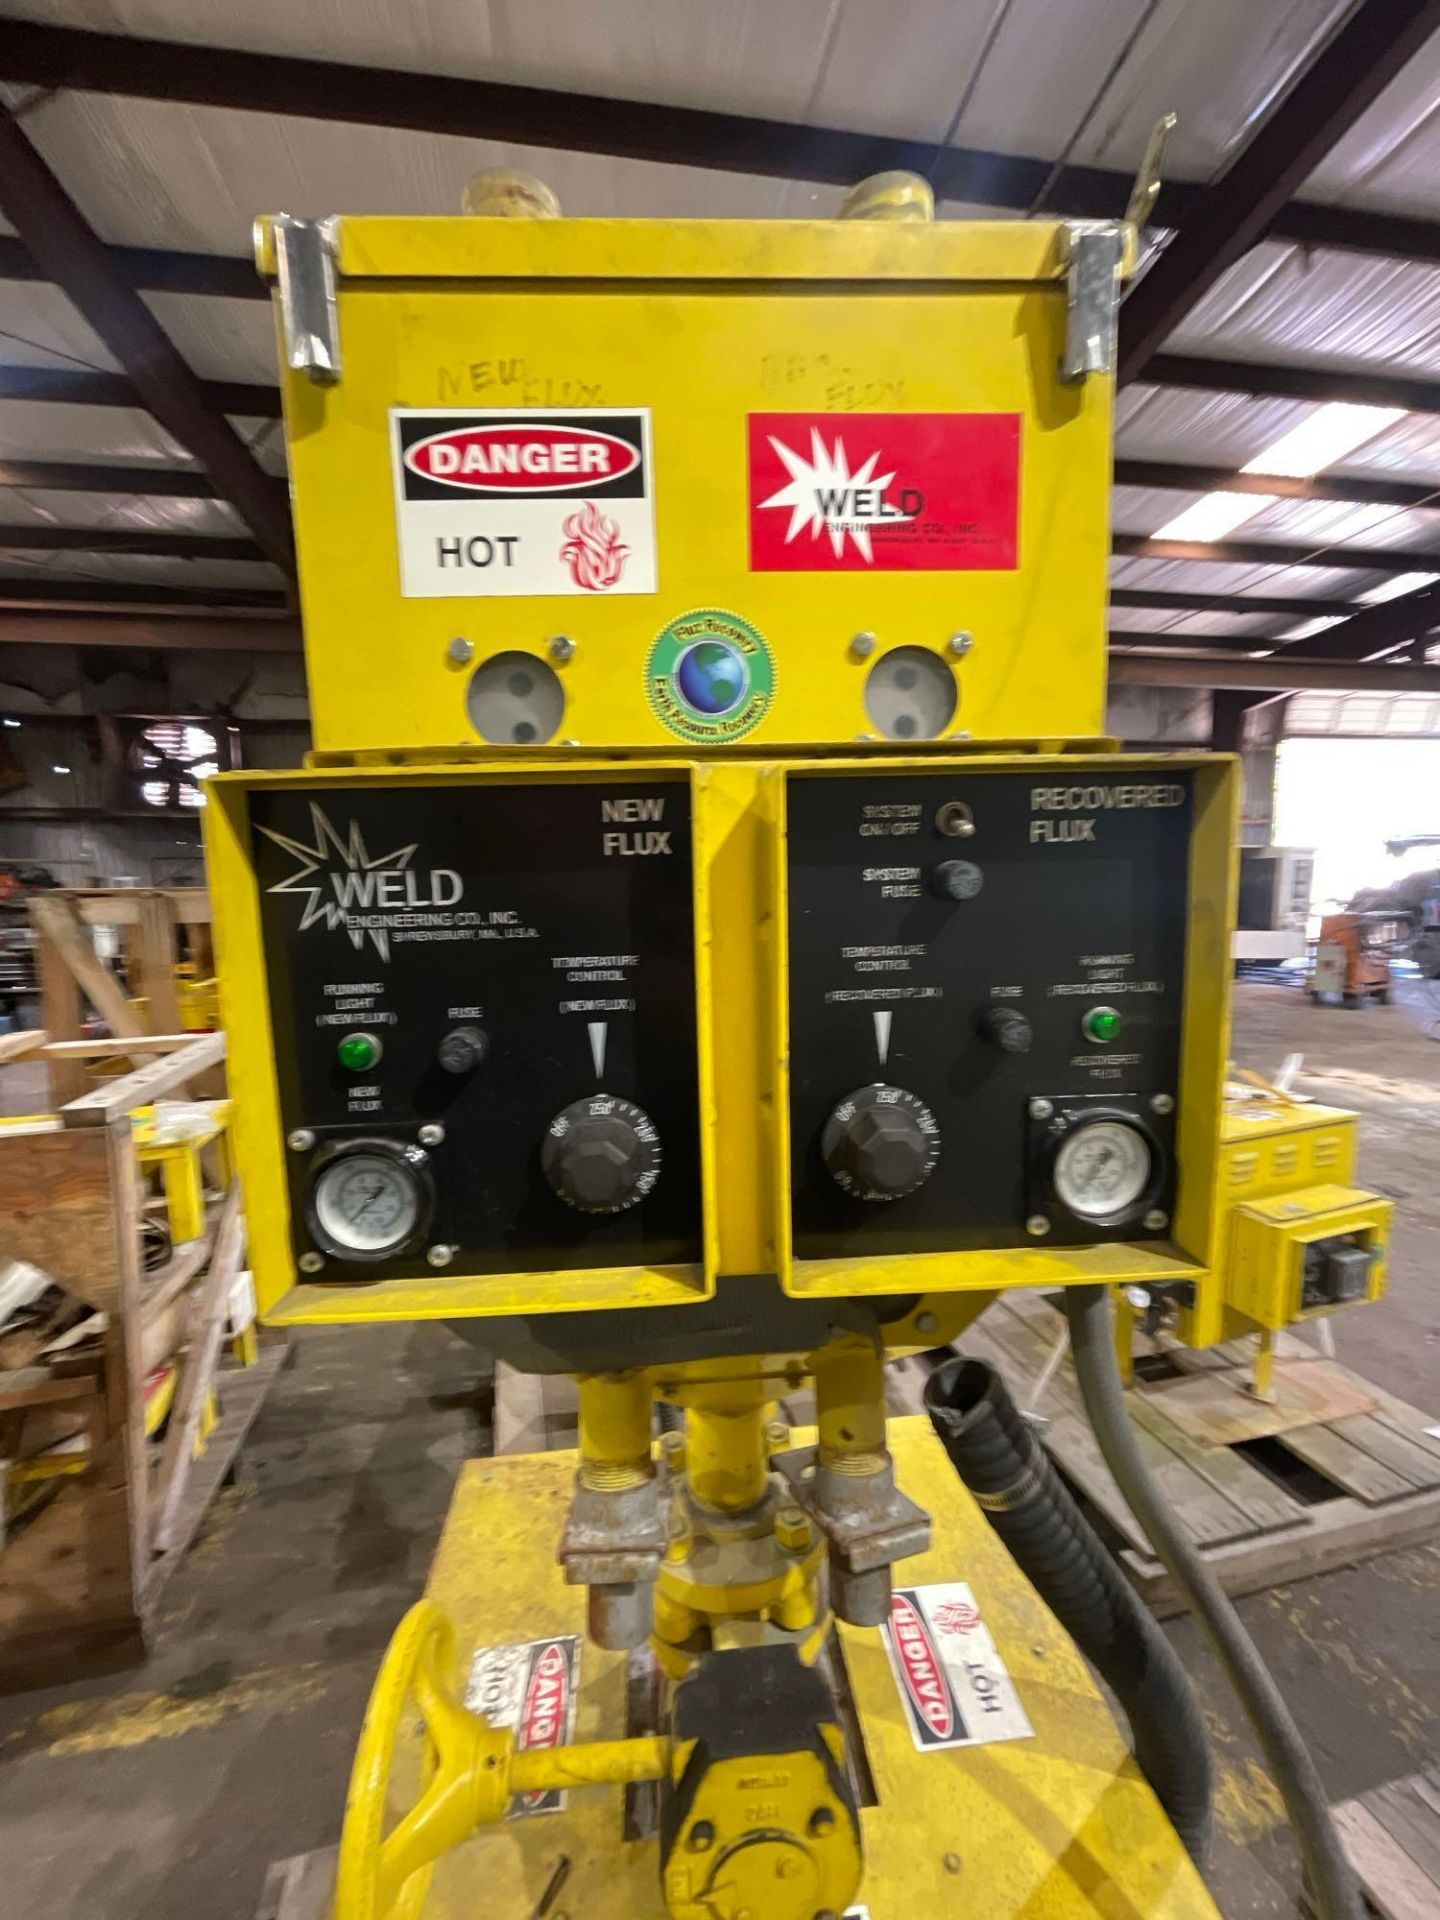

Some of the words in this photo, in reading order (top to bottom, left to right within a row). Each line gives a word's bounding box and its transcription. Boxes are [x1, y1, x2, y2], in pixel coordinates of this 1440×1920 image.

[427, 443, 611, 474] DANGER
[814, 488, 925, 517] WELD
[436, 536, 521, 567] HOT
[1031, 785, 1185, 811] RECOVERED
[602, 799, 665, 823] NEW
[1030, 819, 1095, 843] FLUX
[603, 832, 672, 856] FLUX
[863, 868, 921, 881] SYSTEM
[329, 869, 464, 908] WELD
[881, 885, 921, 898] FUSE
[347, 912, 454, 928] ENGINEERING
[840, 944, 927, 958] TEMPERATURE
[551, 955, 640, 968] TEMPERATURE
[855, 959, 912, 972] CONTROL
[566, 970, 626, 981] CONTROL
[323, 983, 384, 996] RUNNING
[335, 998, 375, 1010] LIGHT
[447, 1007, 484, 1019] FUSE
[348, 1086, 381, 1098] NEW
[348, 1100, 383, 1112] FLUX
[892, 1607, 949, 1720] DANGER
[963, 1660, 1003, 1713] HOT
[529, 1657, 566, 1748] DANG
